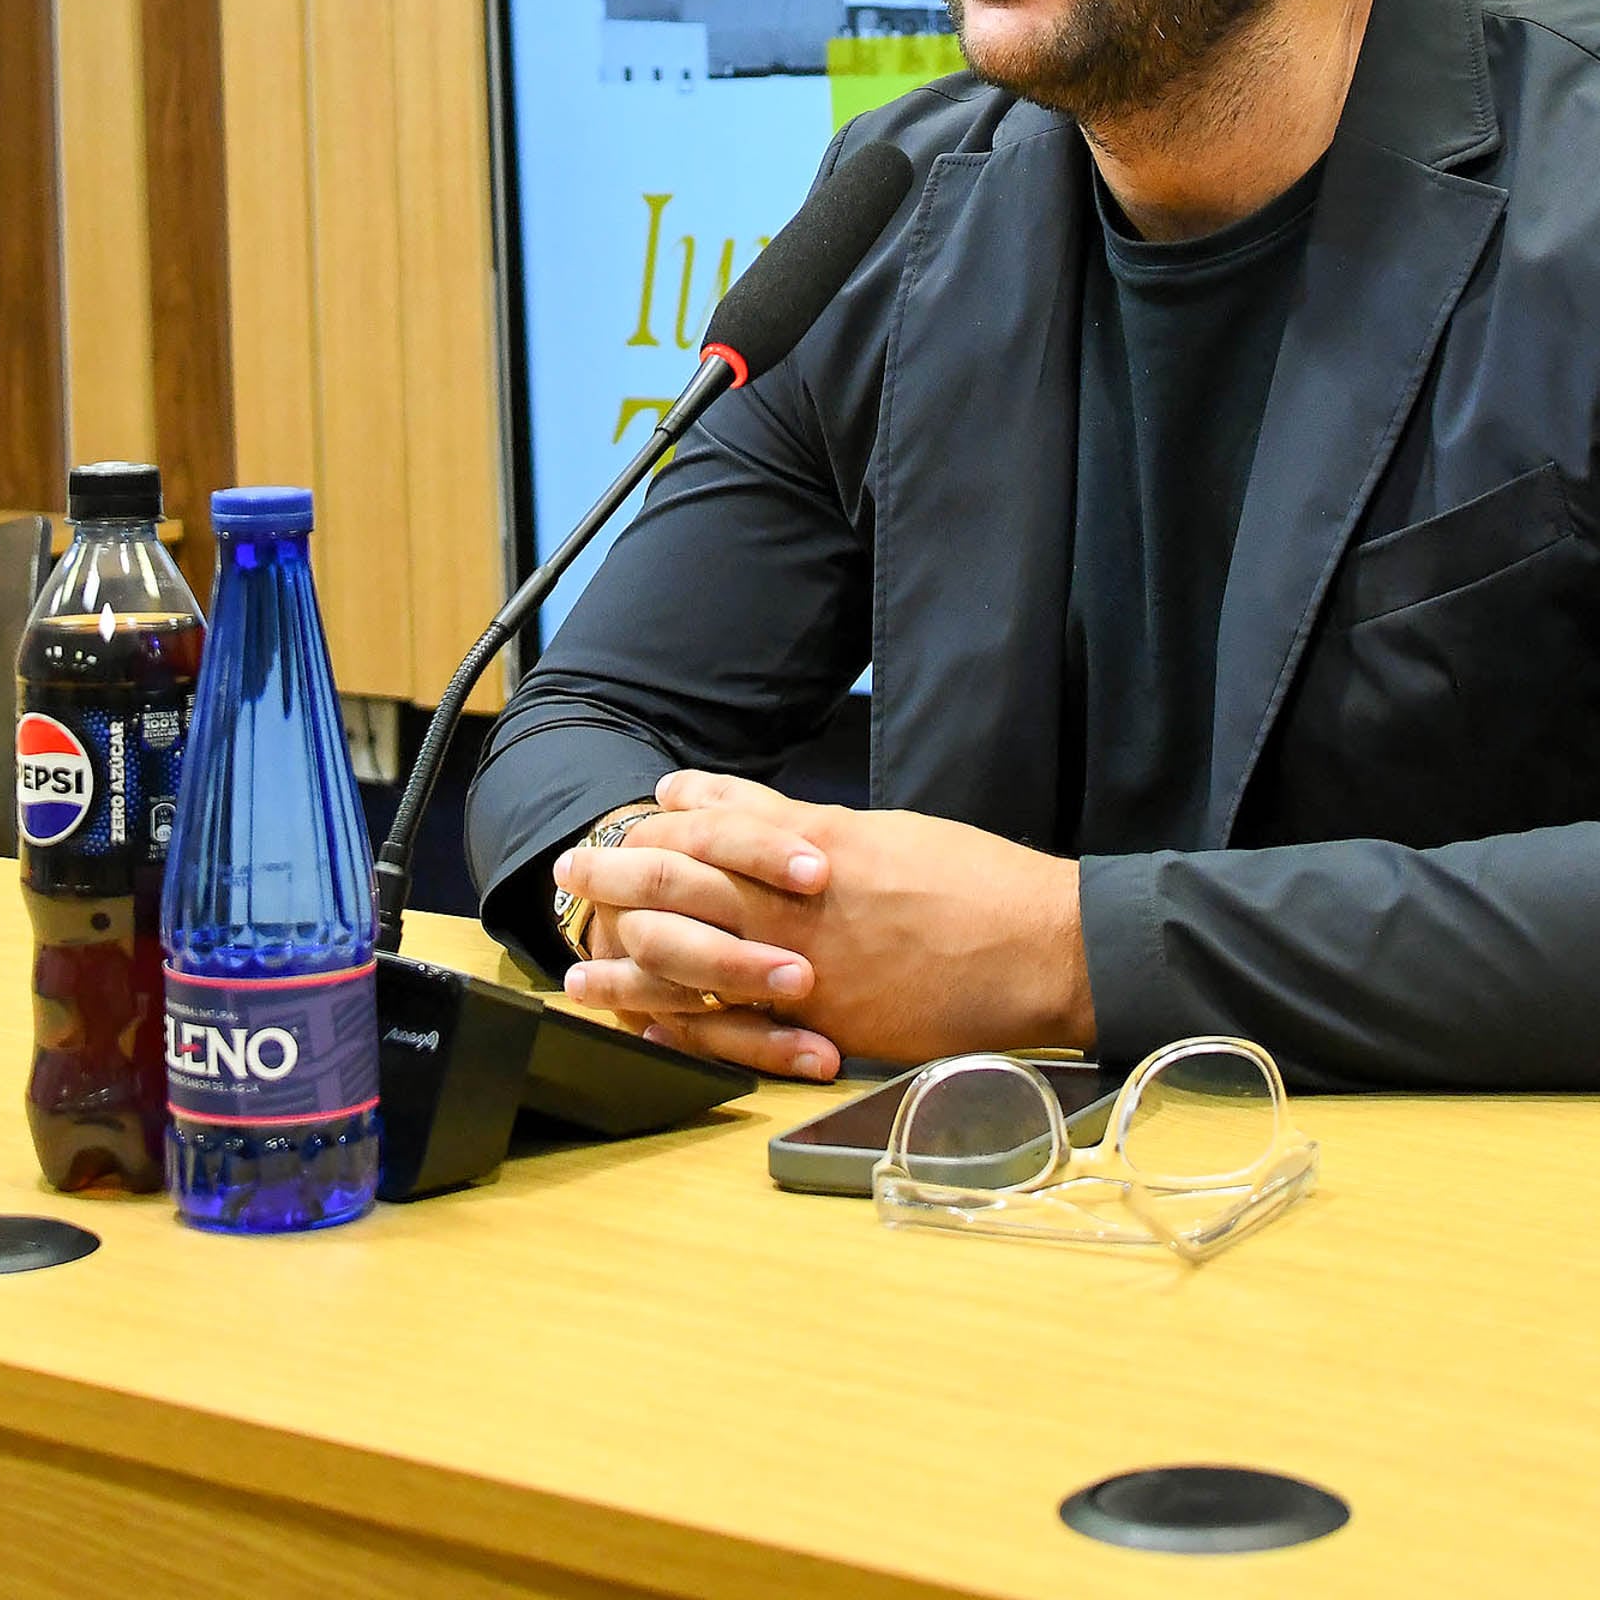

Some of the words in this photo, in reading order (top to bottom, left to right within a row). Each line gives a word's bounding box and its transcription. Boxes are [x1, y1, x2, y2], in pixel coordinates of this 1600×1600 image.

[19, 762, 85, 795] EPSI
[109, 720, 125, 793] AZÚCAR
[110, 794, 126, 844] ZERO
[163, 1012, 299, 1081] LENO
